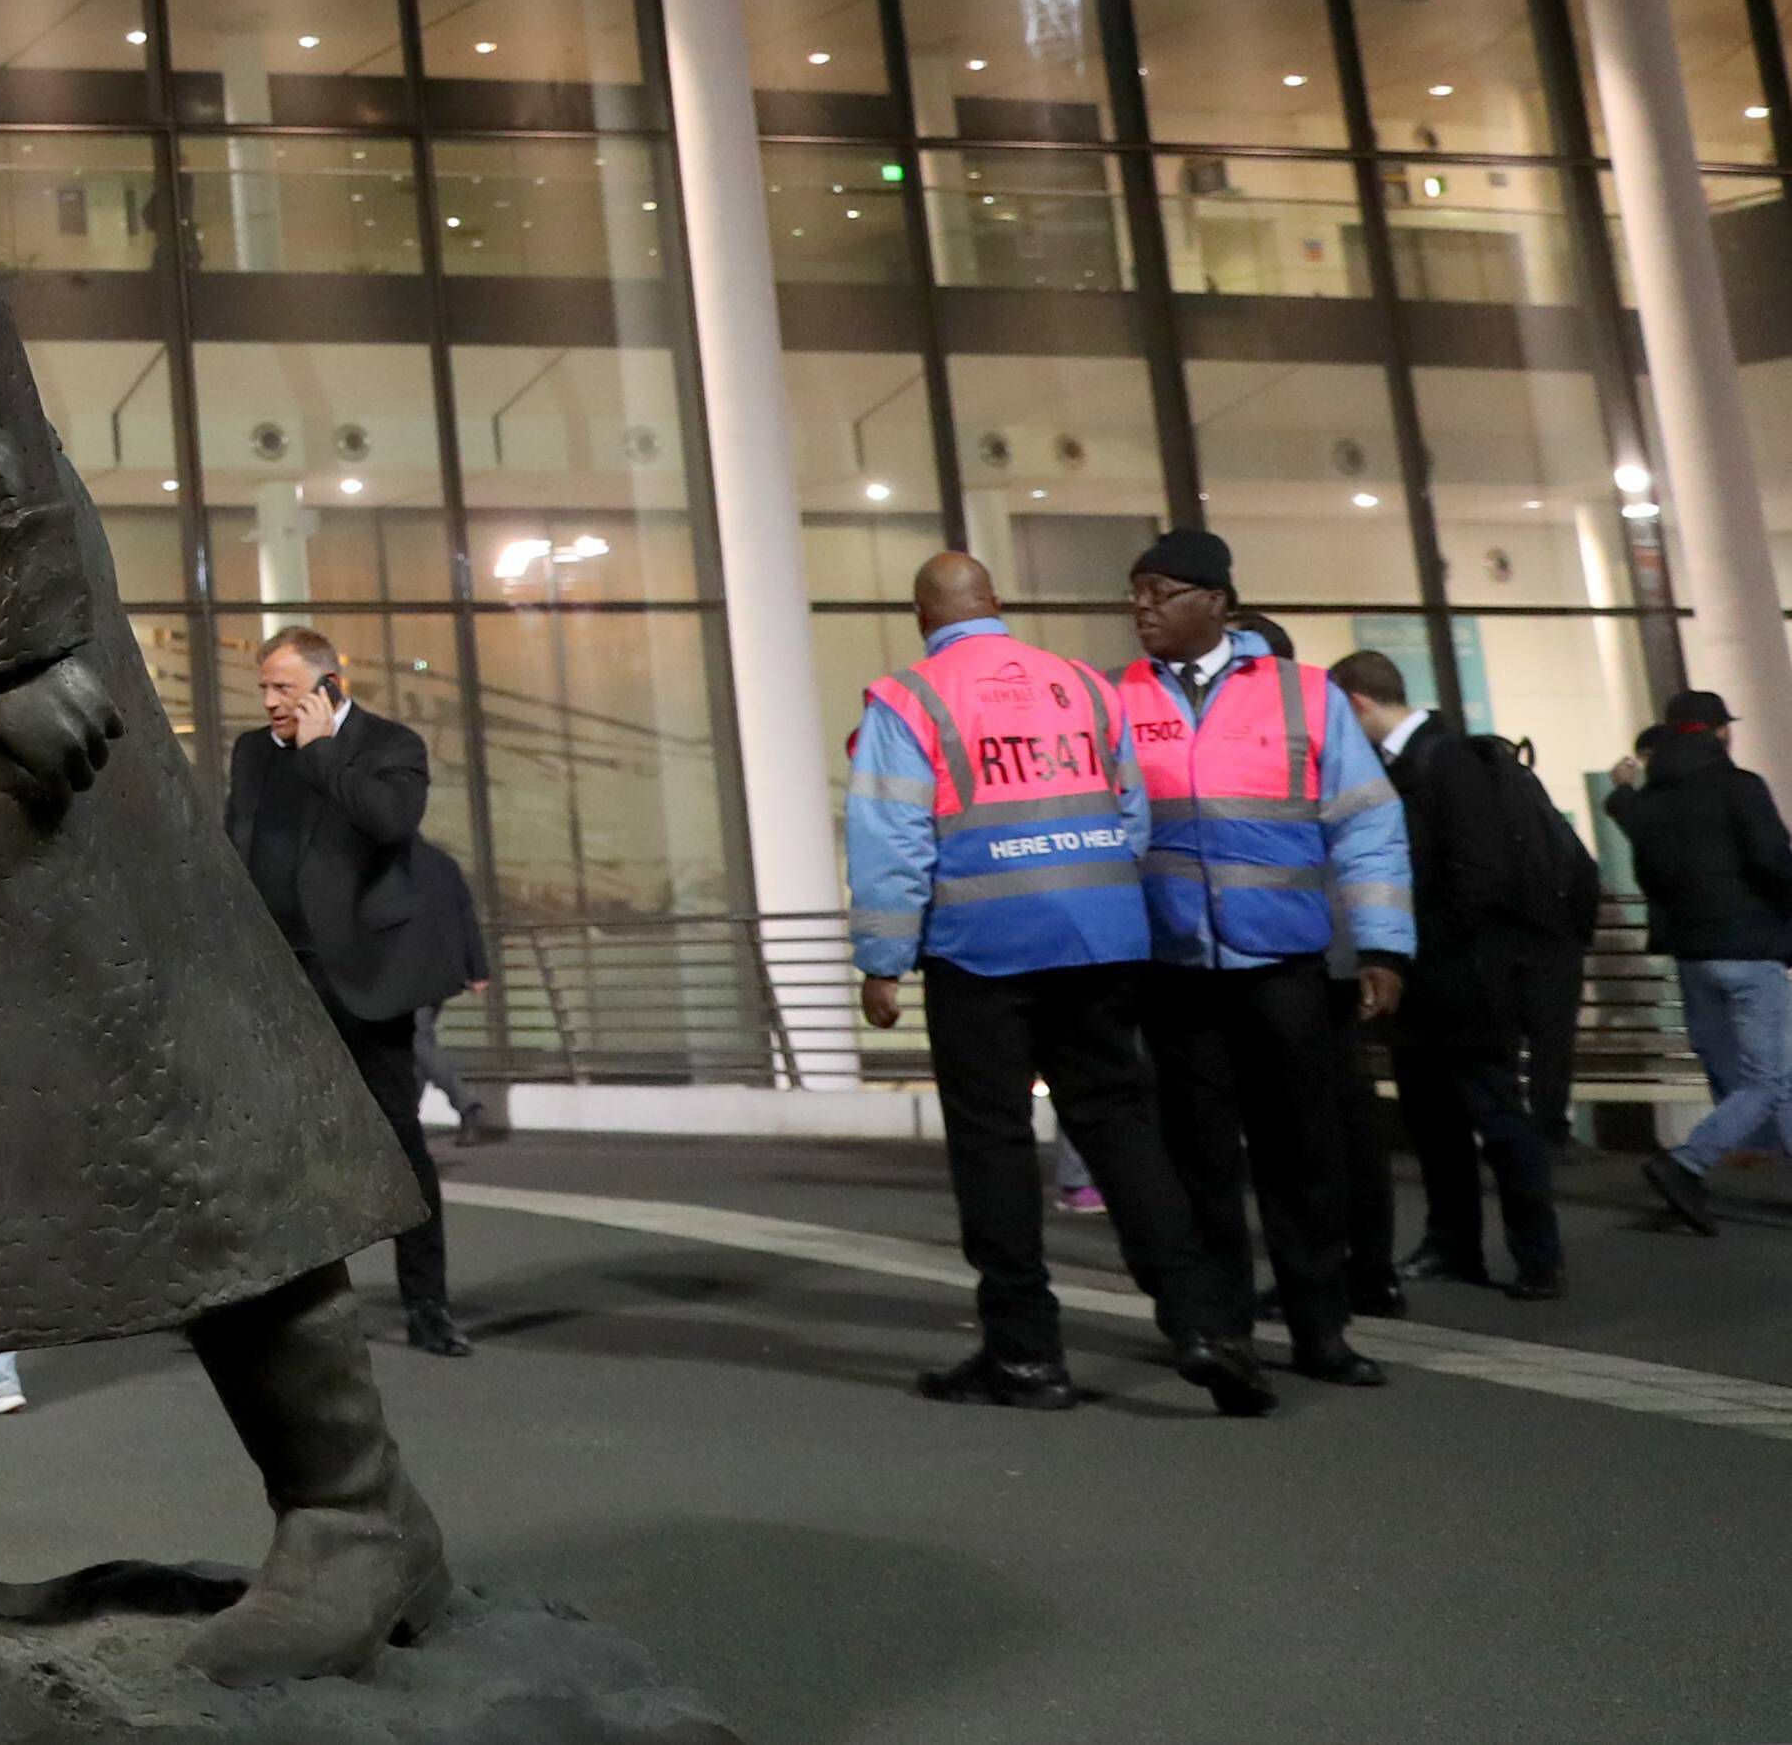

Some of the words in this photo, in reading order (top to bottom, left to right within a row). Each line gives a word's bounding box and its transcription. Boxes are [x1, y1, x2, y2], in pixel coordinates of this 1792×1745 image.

[1050, 683, 1071, 709] 8
[978, 731, 1098, 786] RT547
[989, 834, 1052, 860] HERE
[1049, 831, 1081, 851] TO
[1081, 828, 1127, 848] HELP
